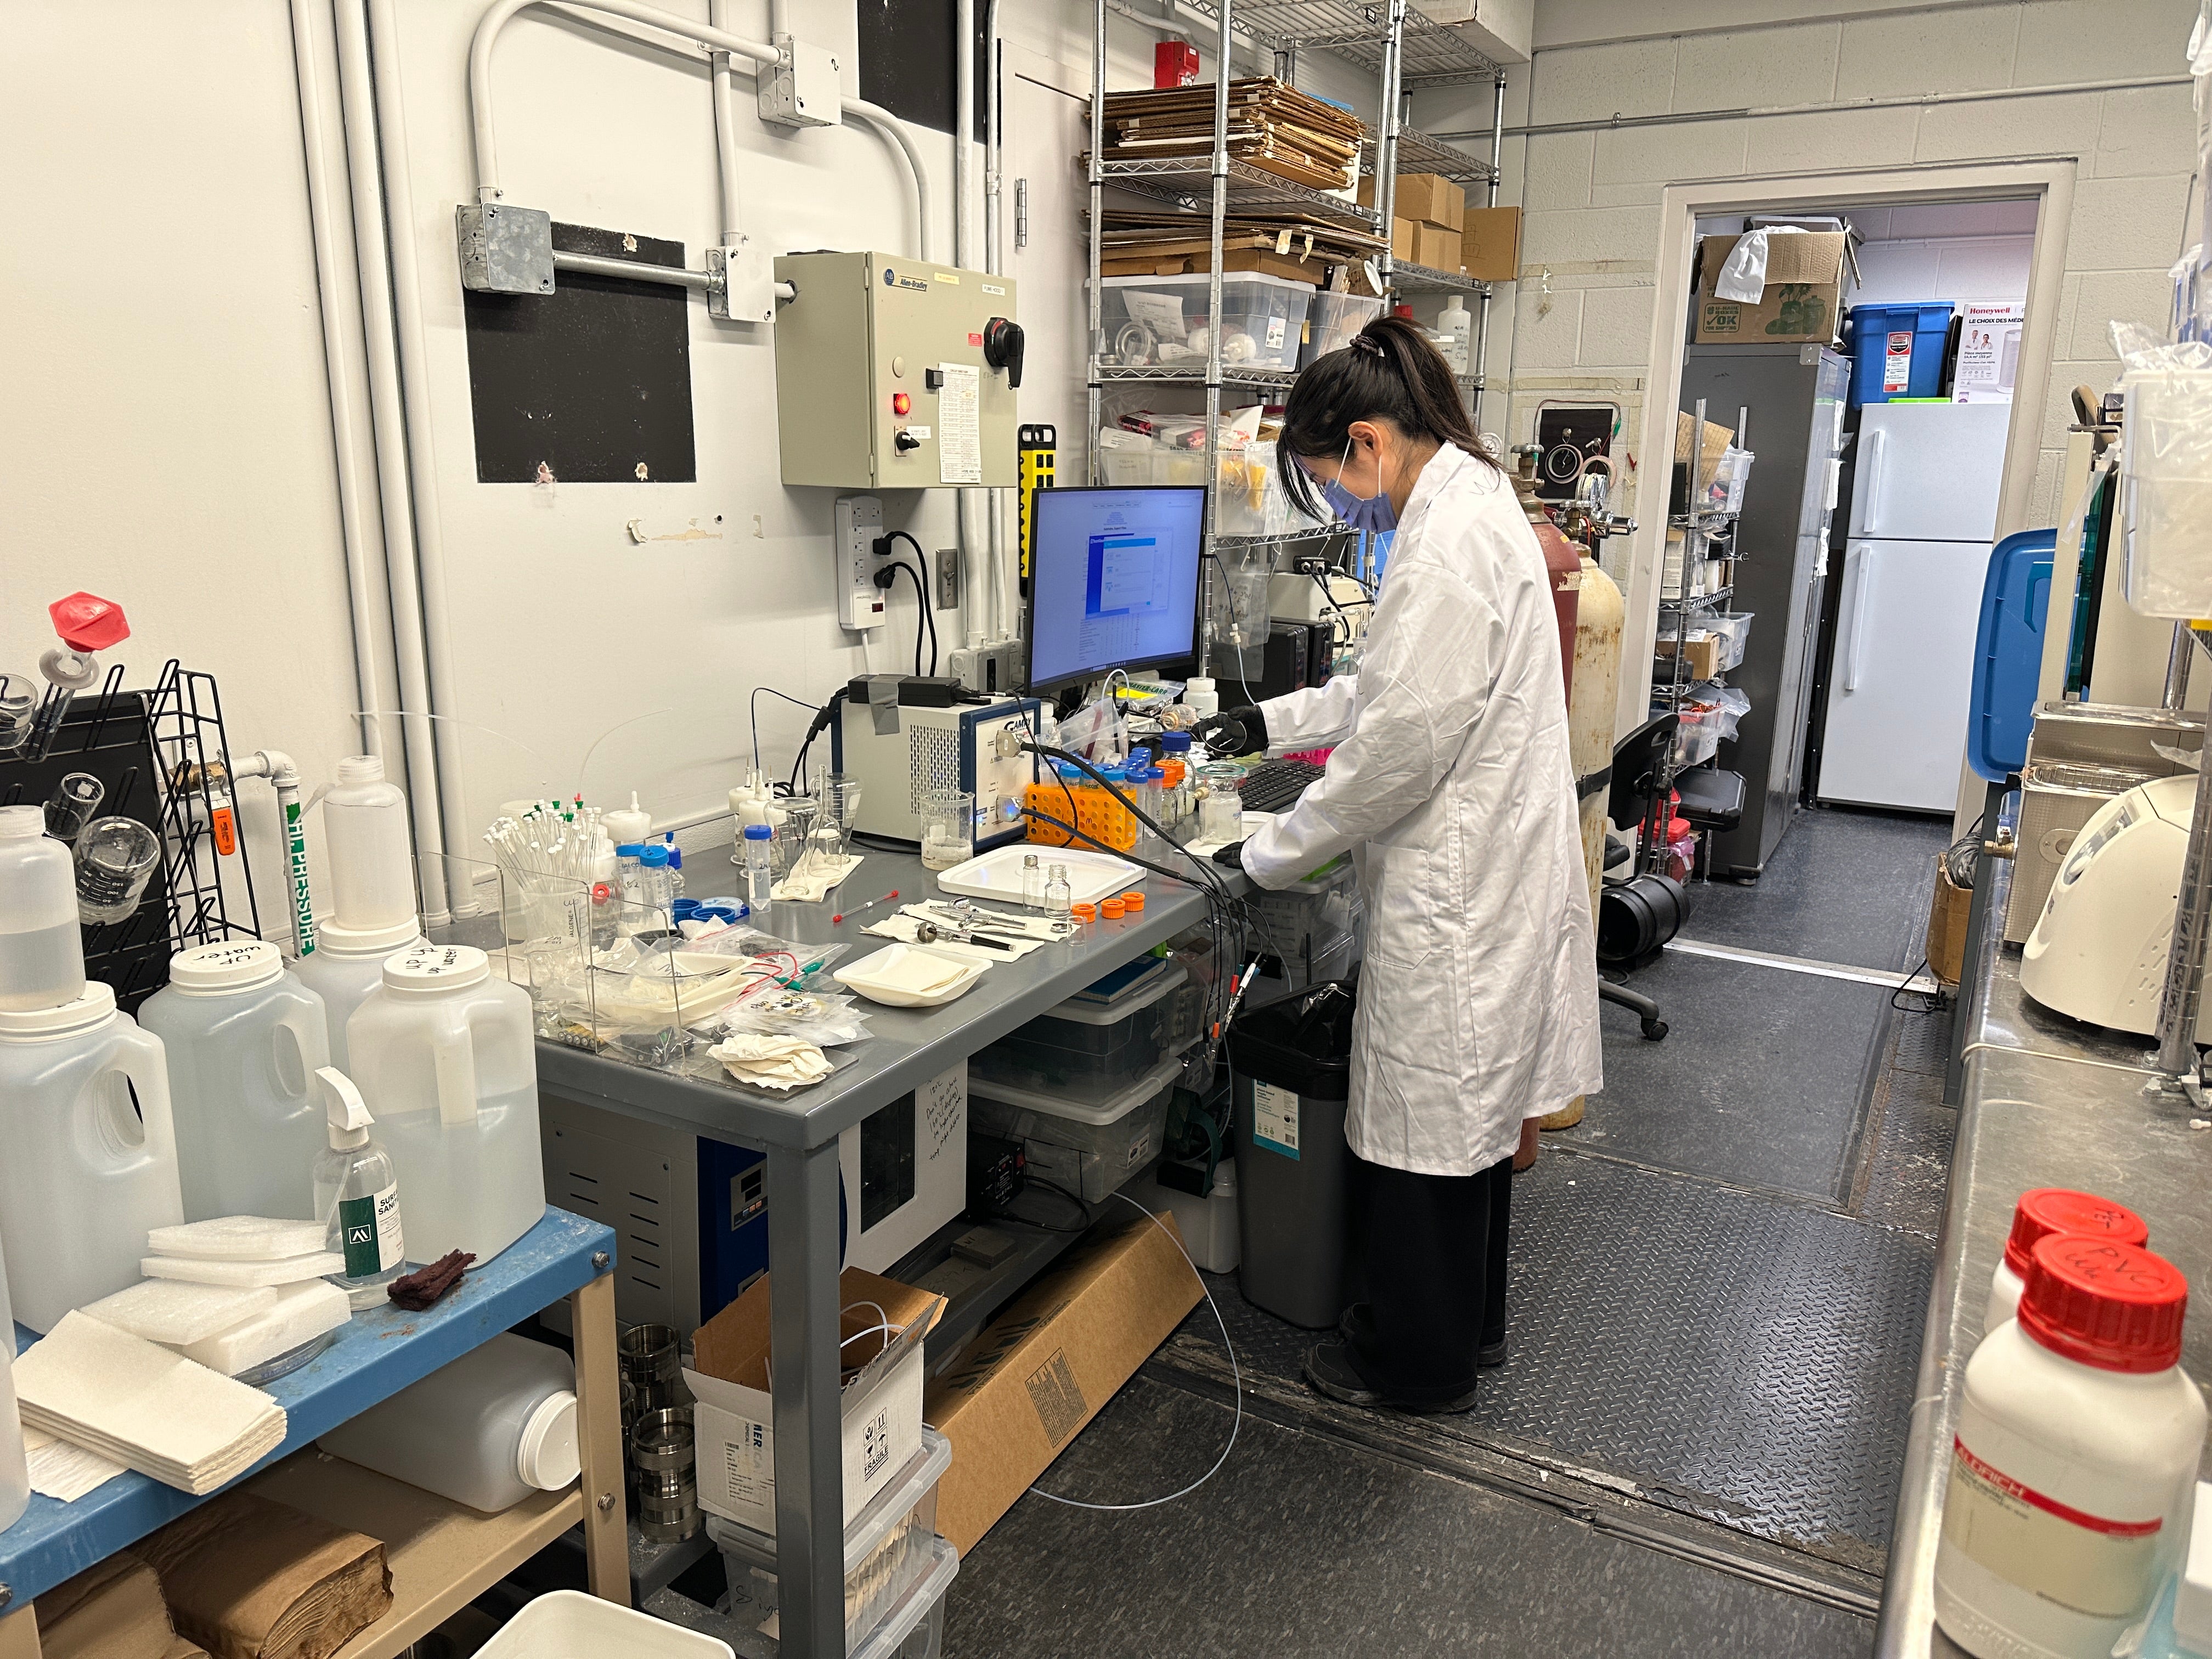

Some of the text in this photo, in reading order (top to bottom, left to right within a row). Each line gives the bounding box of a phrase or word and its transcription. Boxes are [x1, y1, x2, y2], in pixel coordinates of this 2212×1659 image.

[885, 271, 894, 280] AB
[900, 278, 928, 291] Allen-Bradley
[1717, 315, 1737, 325] OK
[292, 851, 315, 950] PRESSURE
[193, 946, 261, 961] water
[219, 955, 251, 965] UP
[442, 948, 458, 966] water
[939, 1094, 945, 1106] go
[946, 1076, 957, 1095] above
[2085, 1246, 2165, 1288] PVC
[864, 1444, 889, 1475] FRAGILE
[1955, 1446, 2025, 1499] ALDRICH
